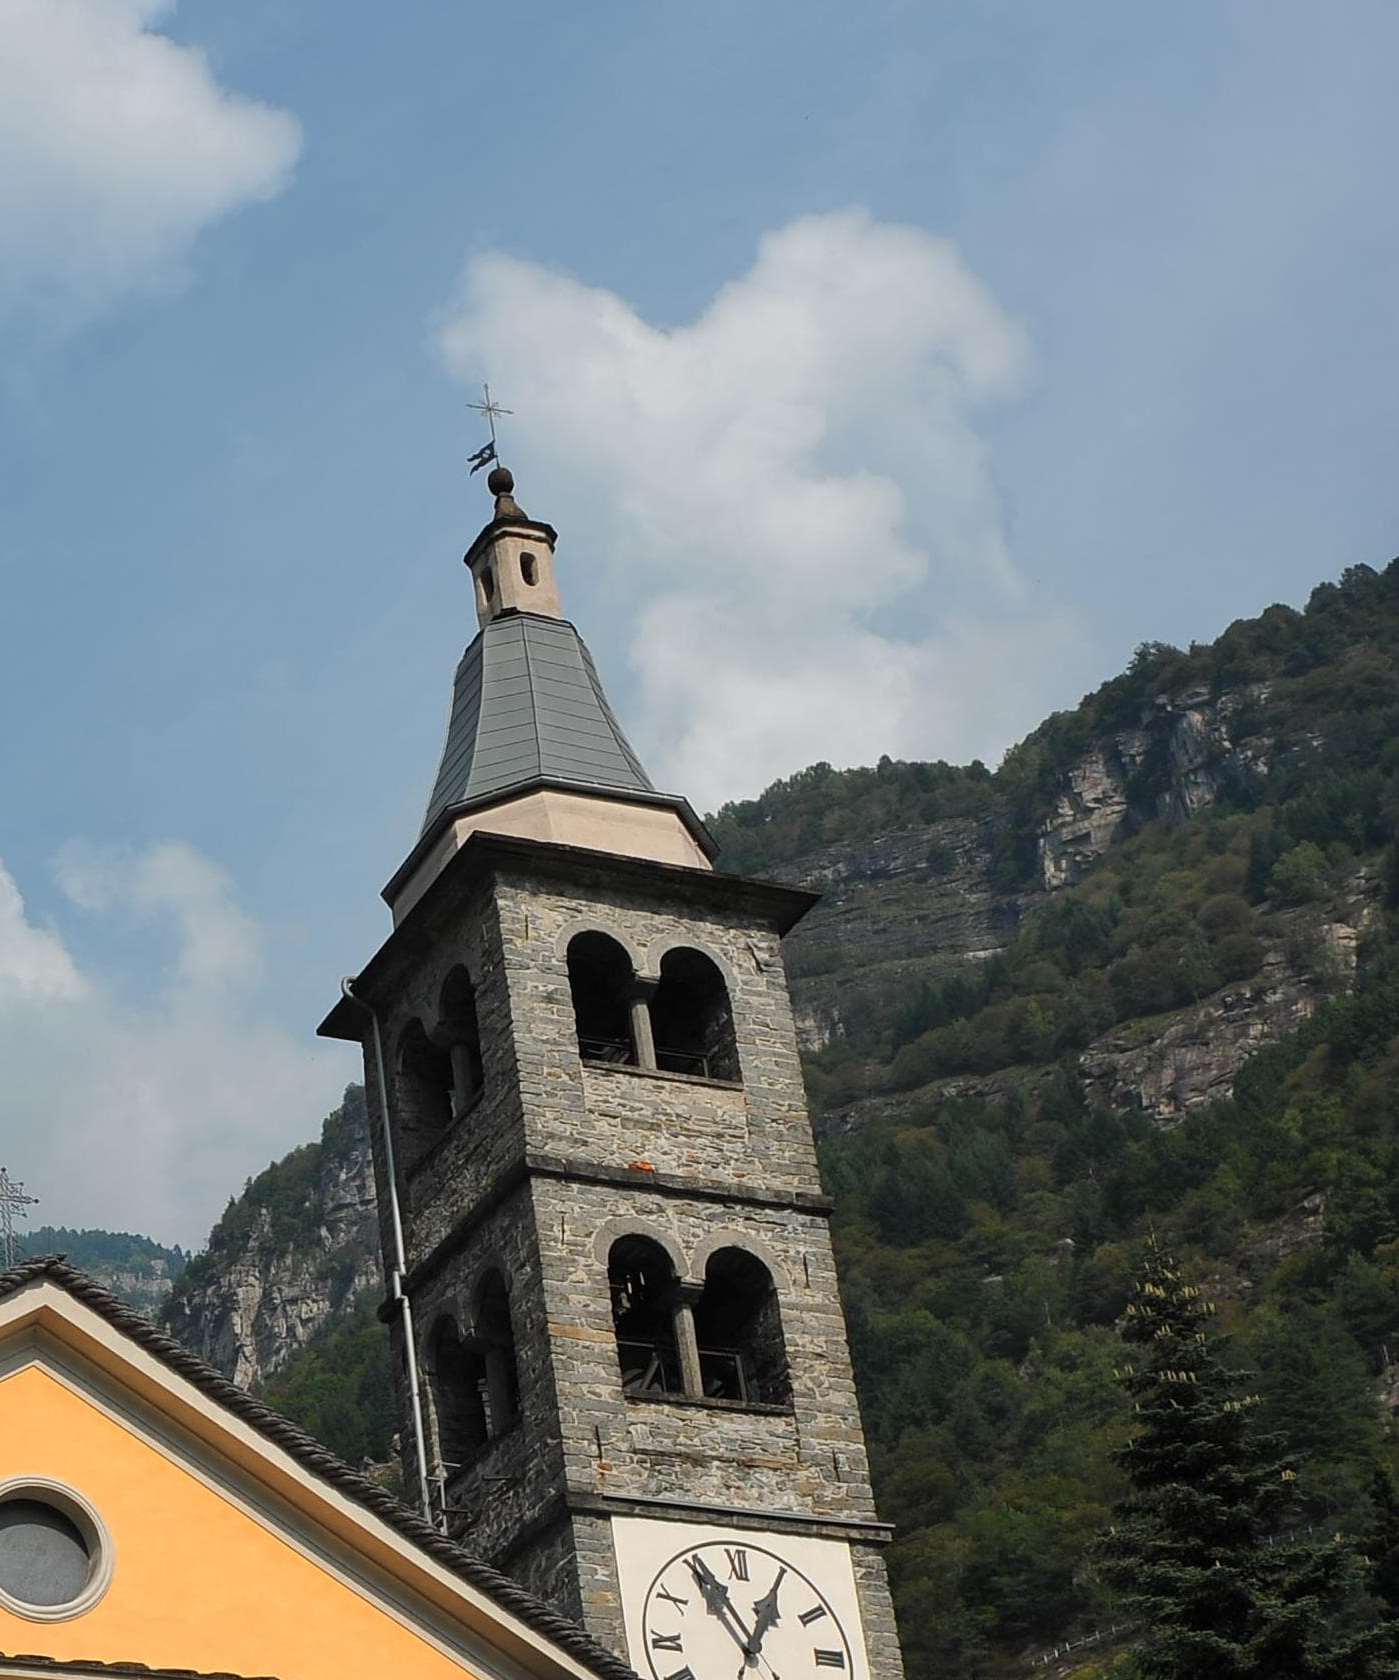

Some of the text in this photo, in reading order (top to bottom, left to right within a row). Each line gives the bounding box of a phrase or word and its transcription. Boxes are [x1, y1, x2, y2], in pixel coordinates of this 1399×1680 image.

[723, 1548, 750, 1582] XII
[655, 1582, 689, 1617] X
[797, 1603, 827, 1628] II
[650, 1628, 683, 1653] IX
[814, 1647, 845, 1670] III
